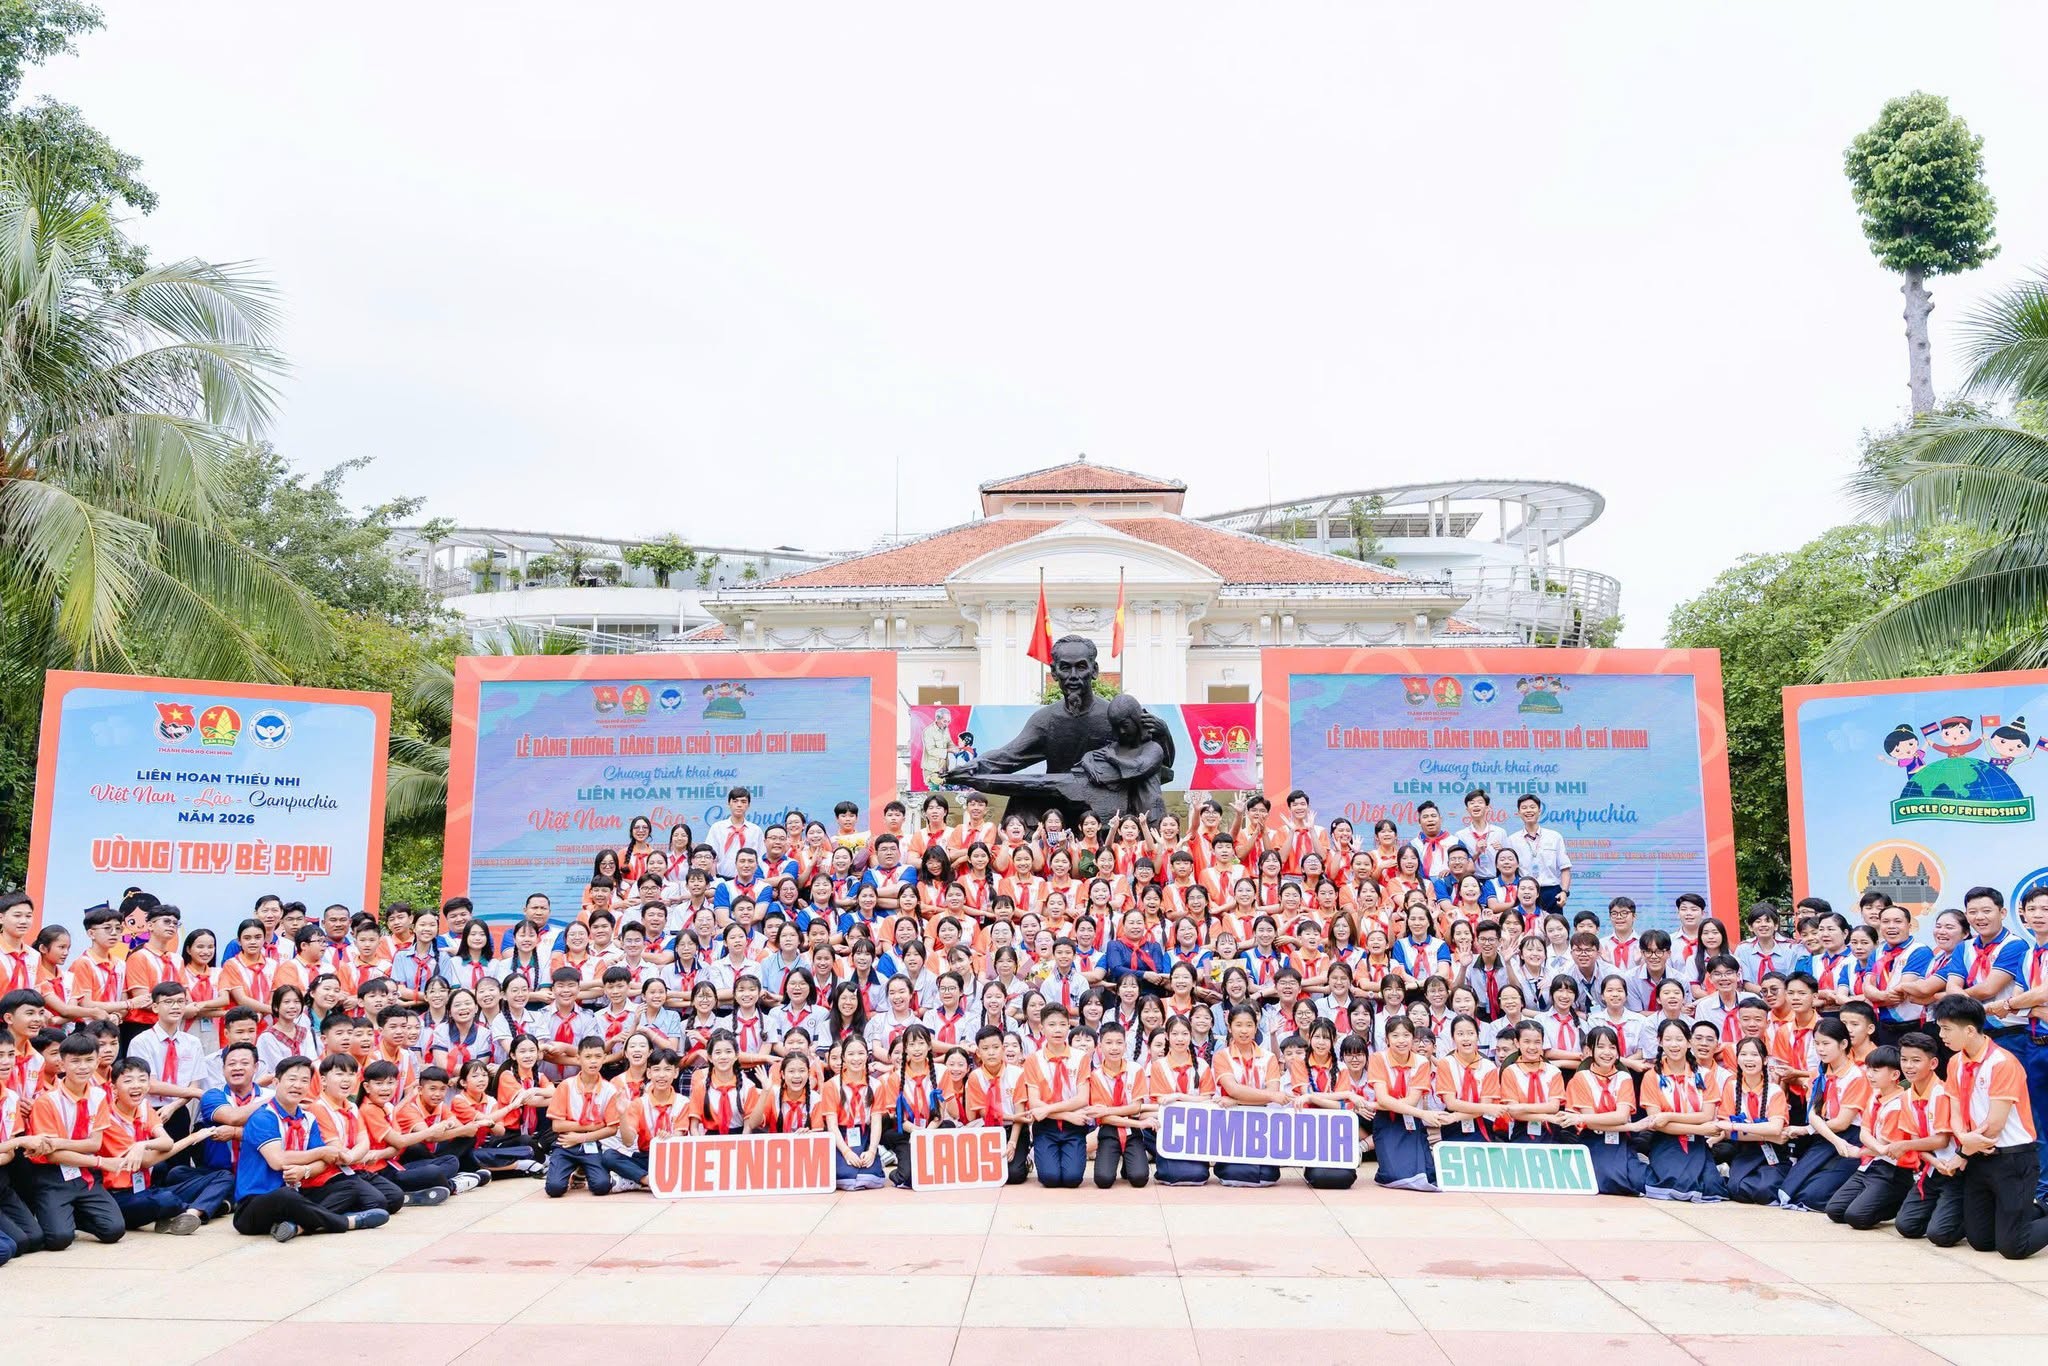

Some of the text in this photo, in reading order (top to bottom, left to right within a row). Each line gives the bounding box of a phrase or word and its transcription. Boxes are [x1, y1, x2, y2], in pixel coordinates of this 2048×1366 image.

[516, 733, 530, 758] LỄ
[533, 736, 567, 756] DÂNG
[620, 734, 654, 755] DÂNG
[658, 736, 682, 754] HOA
[686, 730, 711, 754] CHỦ
[714, 734, 742, 758] TỊCH
[746, 729, 762, 753] HỒ
[766, 730, 788, 753] CHÍ
[791, 734, 826, 752] MINH
[1327, 725, 1340, 748] LỄ
[1344, 726, 1379, 748] DÂNG
[1434, 726, 1470, 748] DÂNG
[1473, 730, 1500, 748] HOA
[1502, 724, 1528, 748] CHỦ
[1532, 730, 1561, 752] TỊCH
[1565, 724, 1583, 748] HỒ
[1586, 727, 1608, 748] CHÍ
[1612, 730, 1648, 748] MINH
[137, 768, 300, 786] LIÊN HOAN THIẾU NHI
[686, 765, 710, 778] khai
[1420, 758, 1559, 780] Chương trình khai mạc
[90, 784, 129, 804] Việt
[132, 785, 176, 803] Nam
[194, 788, 232, 808] Lào
[248, 790, 338, 812] Campuchia
[578, 785, 614, 800] LIÊN
[620, 786, 670, 800] HOAN
[676, 782, 728, 798] THIẾU
[1394, 778, 1434, 794] LIÊN
[1496, 777, 1550, 794] THIẾU
[1556, 782, 1586, 794] NHI
[178, 810, 255, 824] NĂM 2026
[528, 808, 570, 832] Việt
[574, 807, 622, 831] Nam
[1899, 804, 2027, 816] CIRCLE OF FRIENDSHIP
[92, 835, 332, 882] VÒNG TAY BÈ BẠN
[1162, 1105, 1353, 1162] CAMBODIA
[654, 1137, 830, 1193] VIETNAM
[916, 1132, 1003, 1185] LAOS
[1438, 1146, 1592, 1190] SAMAKI
